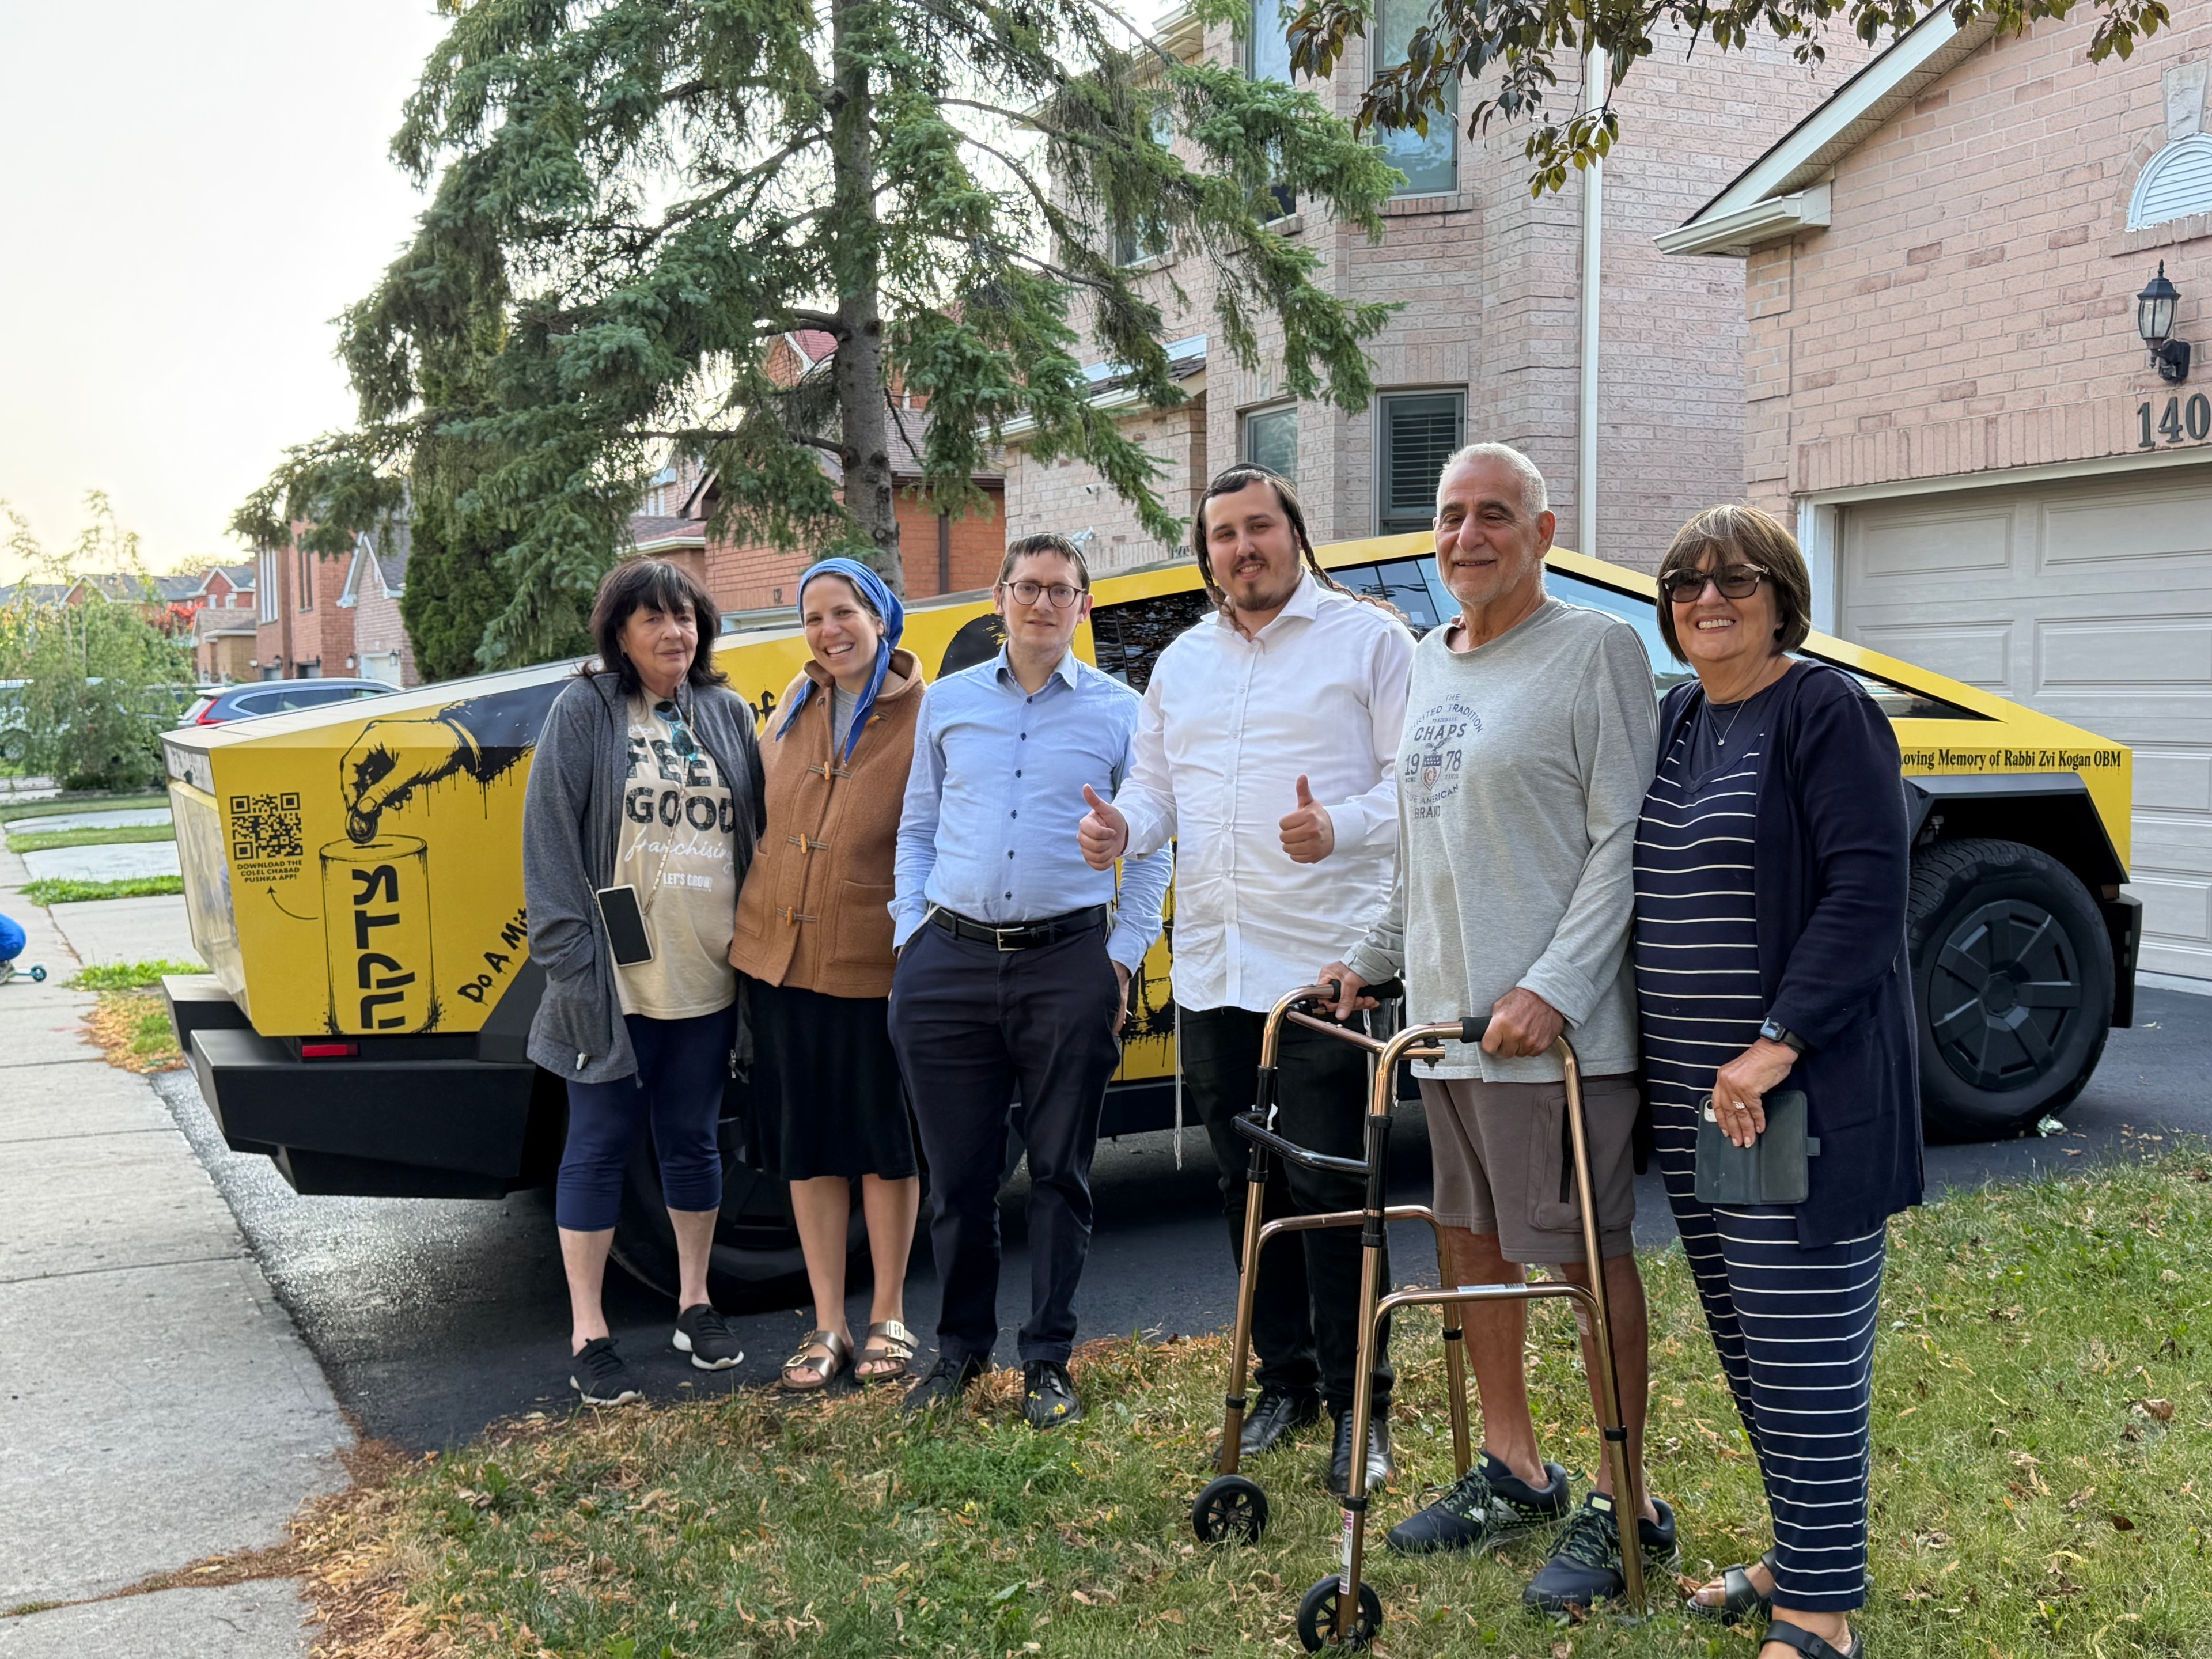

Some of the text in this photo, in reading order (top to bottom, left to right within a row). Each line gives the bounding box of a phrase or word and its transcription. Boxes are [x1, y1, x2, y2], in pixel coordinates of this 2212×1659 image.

[2137, 393, 2211, 448] 140
[1448, 704, 1483, 733] TRADITION
[1414, 723, 1467, 741] CHAPS
[1404, 749, 1462, 775] 19 78
[1902, 749, 2121, 771] oving Memory of Rabbi Zvi Kogan OBM
[1420, 783, 1459, 804] AMERICAN
[237, 861, 285, 870] DOWNLOAD
[663, 872, 685, 885] LET'S
[351, 865, 415, 1029] צדקה
[457, 974, 493, 1003] Do
[483, 952, 509, 974] A
